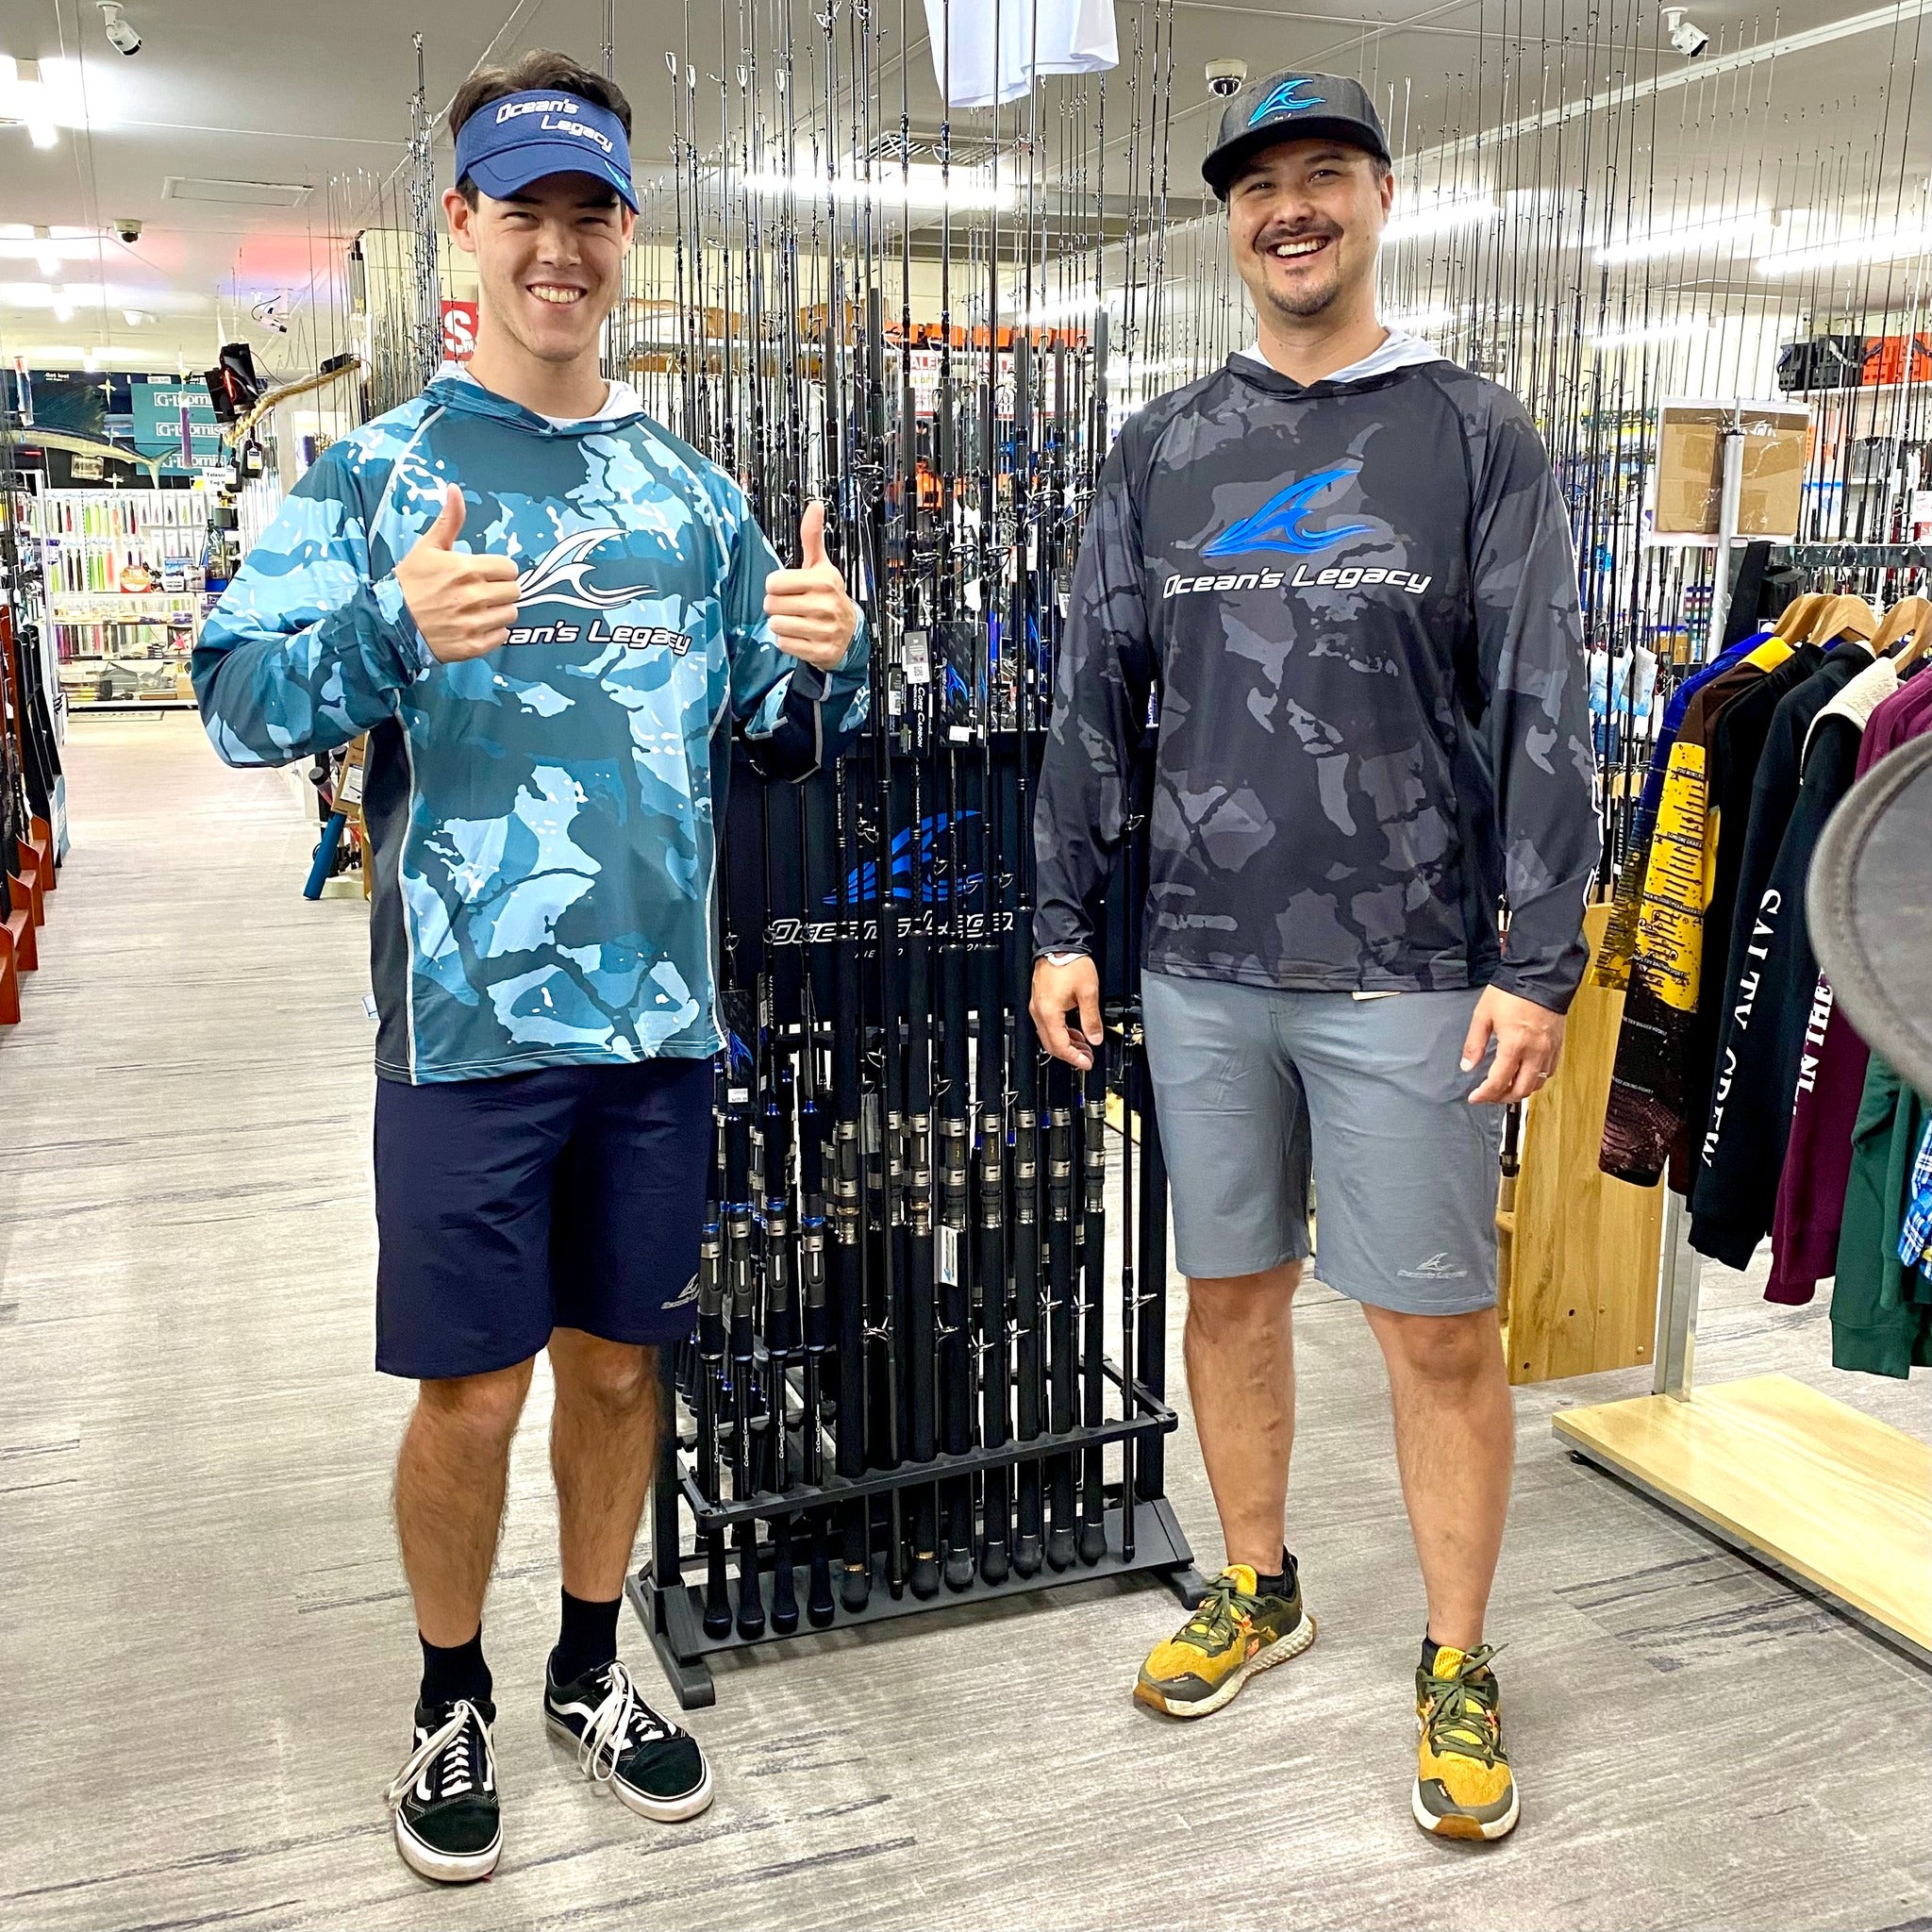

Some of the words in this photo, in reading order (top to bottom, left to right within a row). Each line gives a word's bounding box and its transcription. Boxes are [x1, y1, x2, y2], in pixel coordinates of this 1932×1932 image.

[495, 98, 580, 125] Ocean's
[541, 114, 613, 154] Legacy
[1162, 567, 1285, 599] Ocean's
[1291, 564, 1433, 594] Legacy
[502, 620, 580, 645] an's
[587, 620, 692, 657] Legacy
